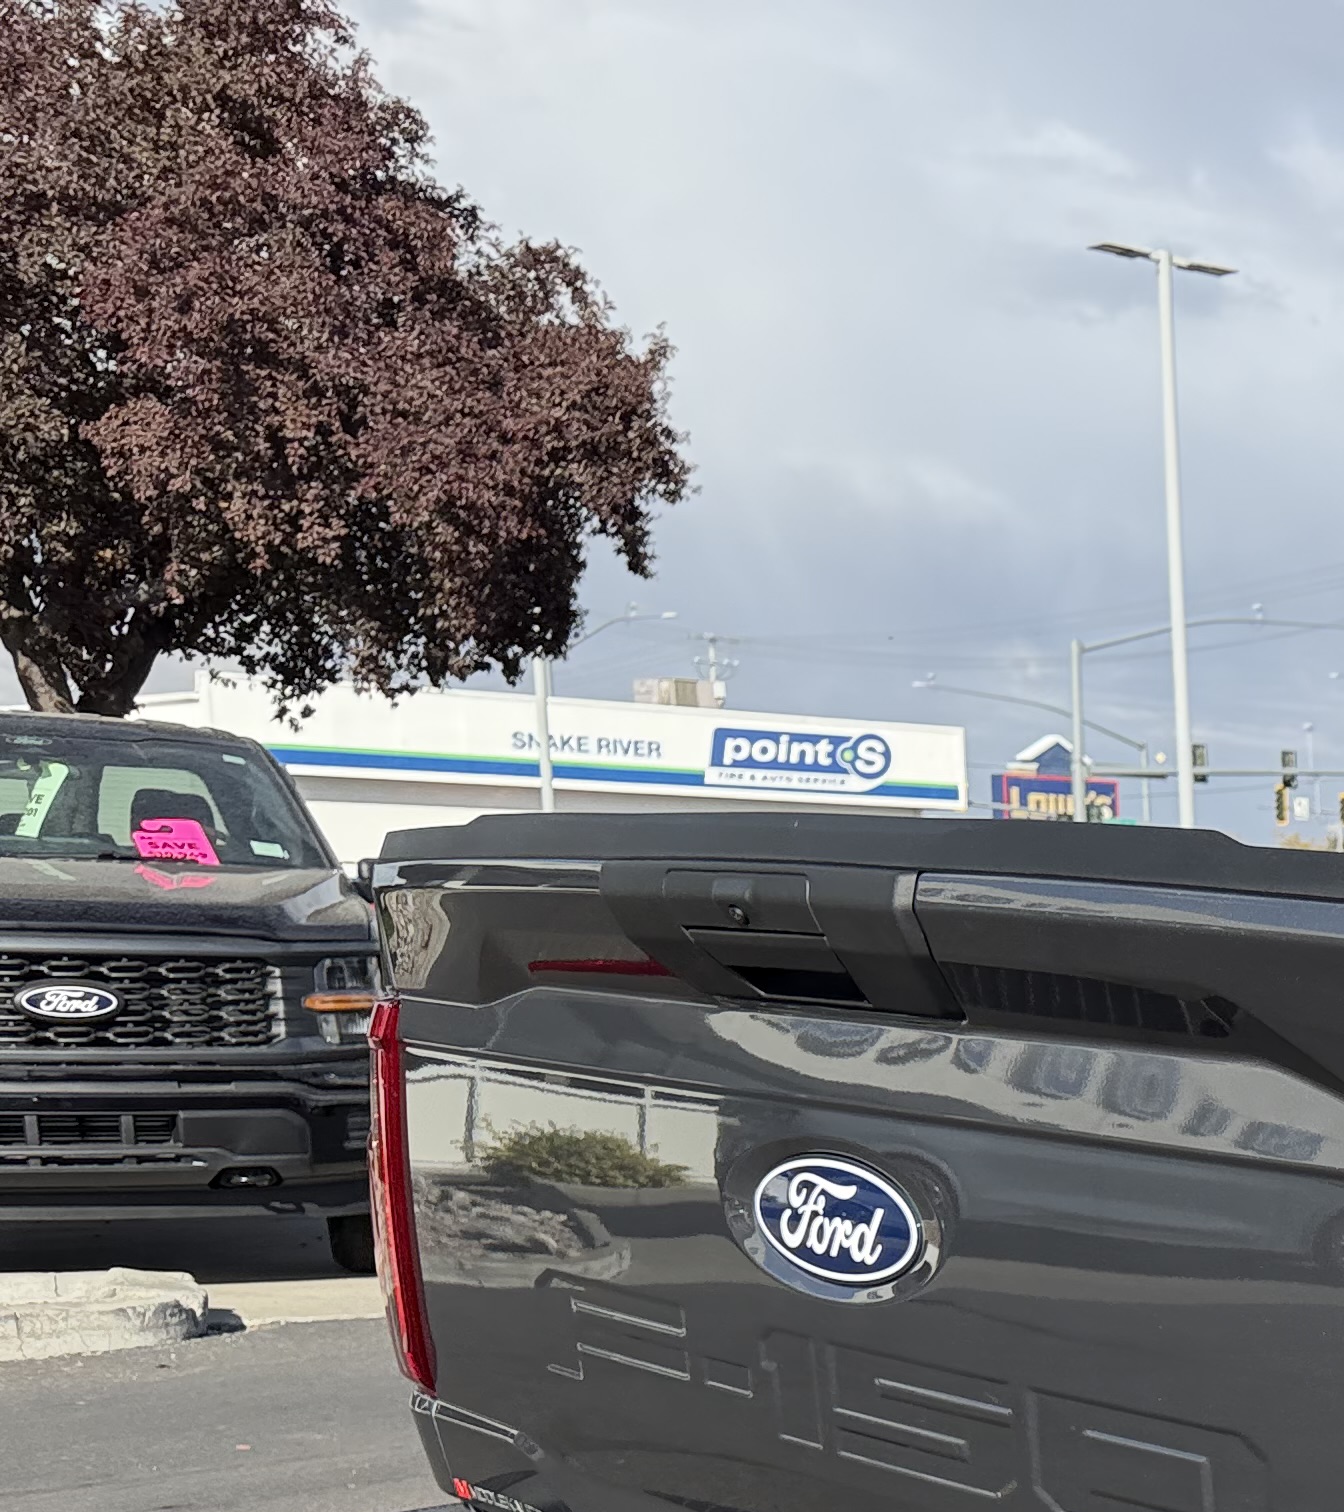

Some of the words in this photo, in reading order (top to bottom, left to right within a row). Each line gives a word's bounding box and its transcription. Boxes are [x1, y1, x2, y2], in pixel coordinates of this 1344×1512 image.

[512, 731, 590, 754] SNAKE
[597, 737, 662, 759] RIVER
[40, 990, 100, 1012] Ford
[780, 1172, 884, 1265] Ford
